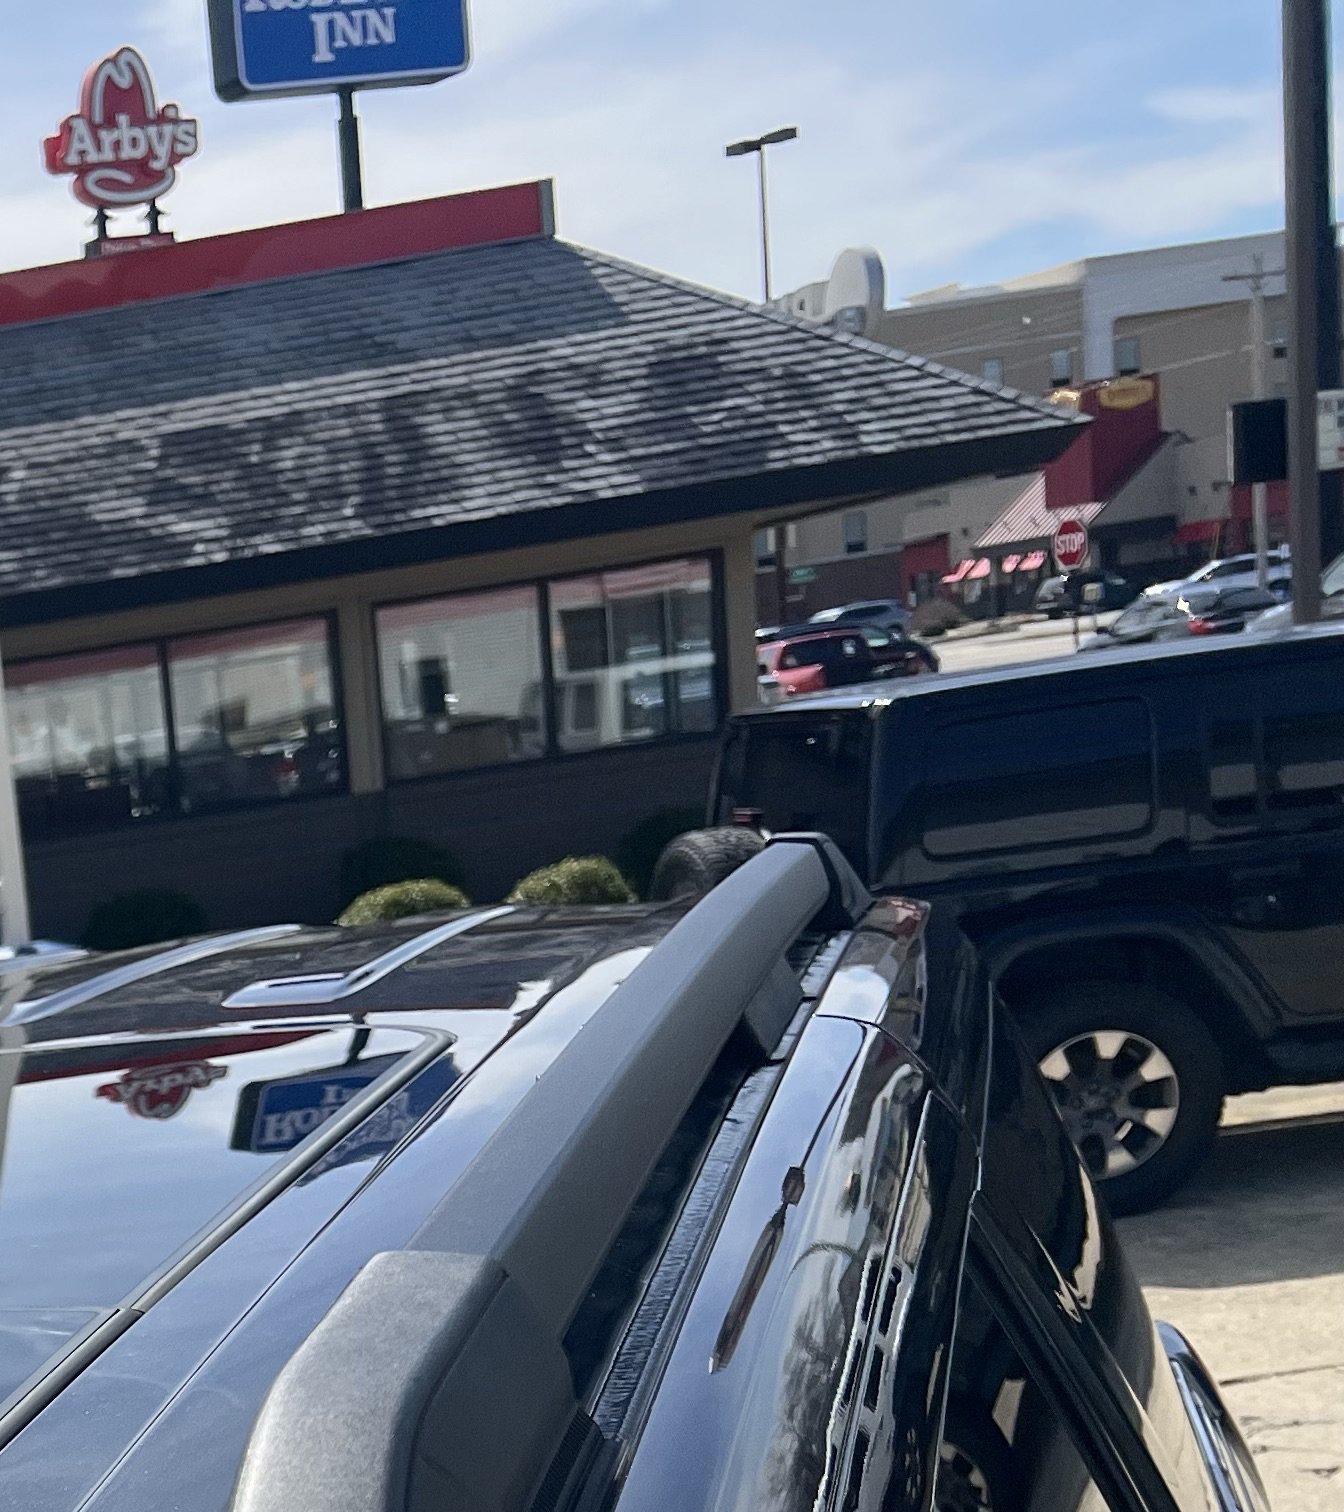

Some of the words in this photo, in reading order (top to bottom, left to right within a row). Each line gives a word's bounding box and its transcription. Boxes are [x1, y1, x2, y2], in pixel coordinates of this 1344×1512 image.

[310, 7, 396, 63] INN
[64, 104, 198, 171] Arby's
[1055, 531, 1085, 555] STOP
